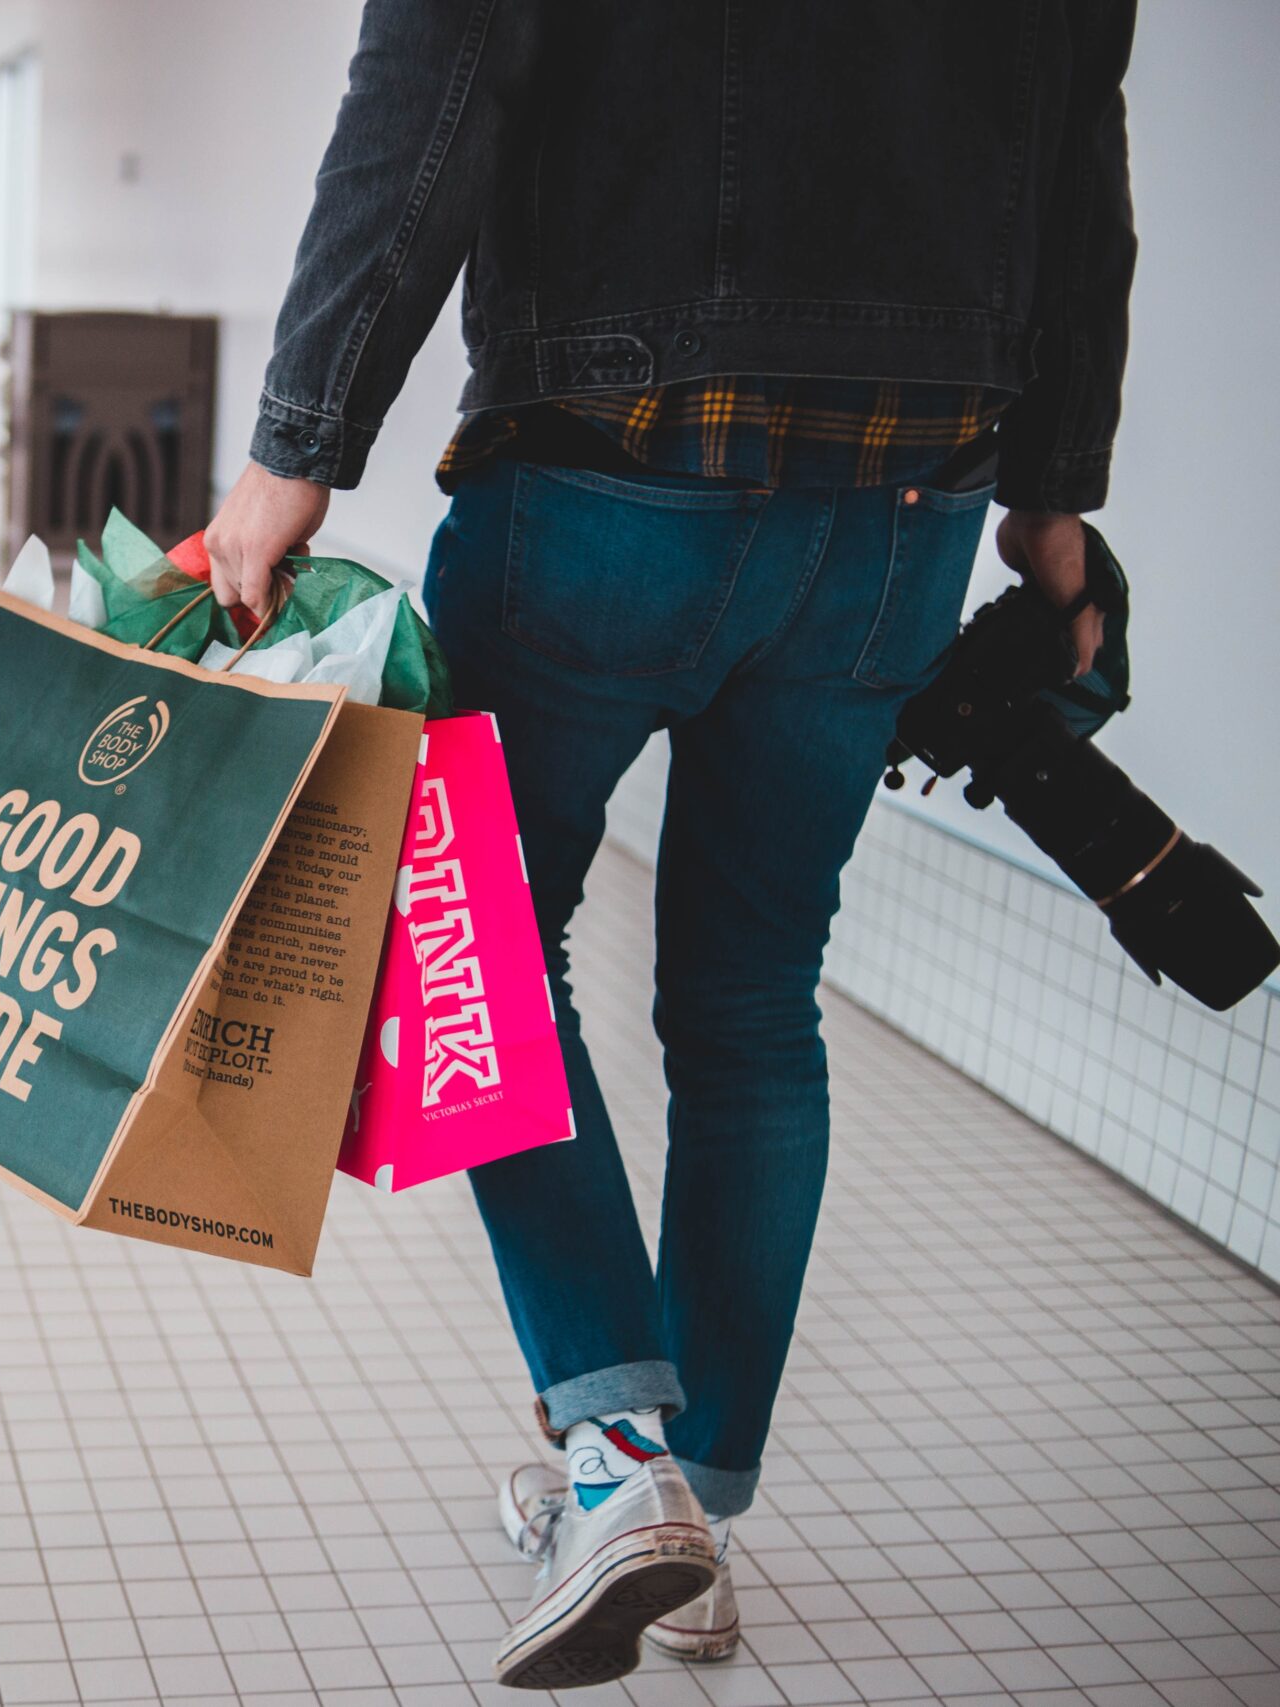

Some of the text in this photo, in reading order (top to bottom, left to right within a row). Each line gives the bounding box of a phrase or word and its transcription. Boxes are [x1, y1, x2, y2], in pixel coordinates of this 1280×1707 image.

[117, 721, 144, 739] THE
[97, 734, 143, 756] BODY
[88, 750, 127, 770] SHOP
[296, 800, 339, 815] oddick
[288, 814, 368, 838] volutionary;
[316, 833, 336, 845] for
[339, 839, 373, 853] good.
[294, 845, 315, 857] the
[319, 850, 359, 866] mould
[296, 859, 334, 878] Today
[338, 869, 362, 882] our
[284, 873, 314, 889] than
[318, 881, 350, 896] ever.
[271, 886, 291, 899] the
[294, 892, 339, 909] planet.
[238, 911, 342, 941] ing communities
[271, 903, 322, 922] farmers
[326, 915, 351, 927] and
[231, 927, 346, 957] ucts enrich, never
[246, 945, 270, 958] and
[274, 951, 297, 962] are
[300, 955, 338, 971] never
[243, 960, 265, 972] are
[269, 964, 307, 980] proud
[312, 971, 325, 983] to
[329, 974, 344, 987] be
[225, 986, 249, 999] can
[253, 991, 268, 1002] do
[272, 994, 286, 1007] it.
[239, 972, 345, 1003] for what's right.
[190, 1008, 275, 1054] ENRICH
[207, 1067, 254, 1090] hands)
[422, 1090, 504, 1122] VICTORIA'S SECRET
[108, 1197, 274, 1249] THEBODYSHOP.COM
